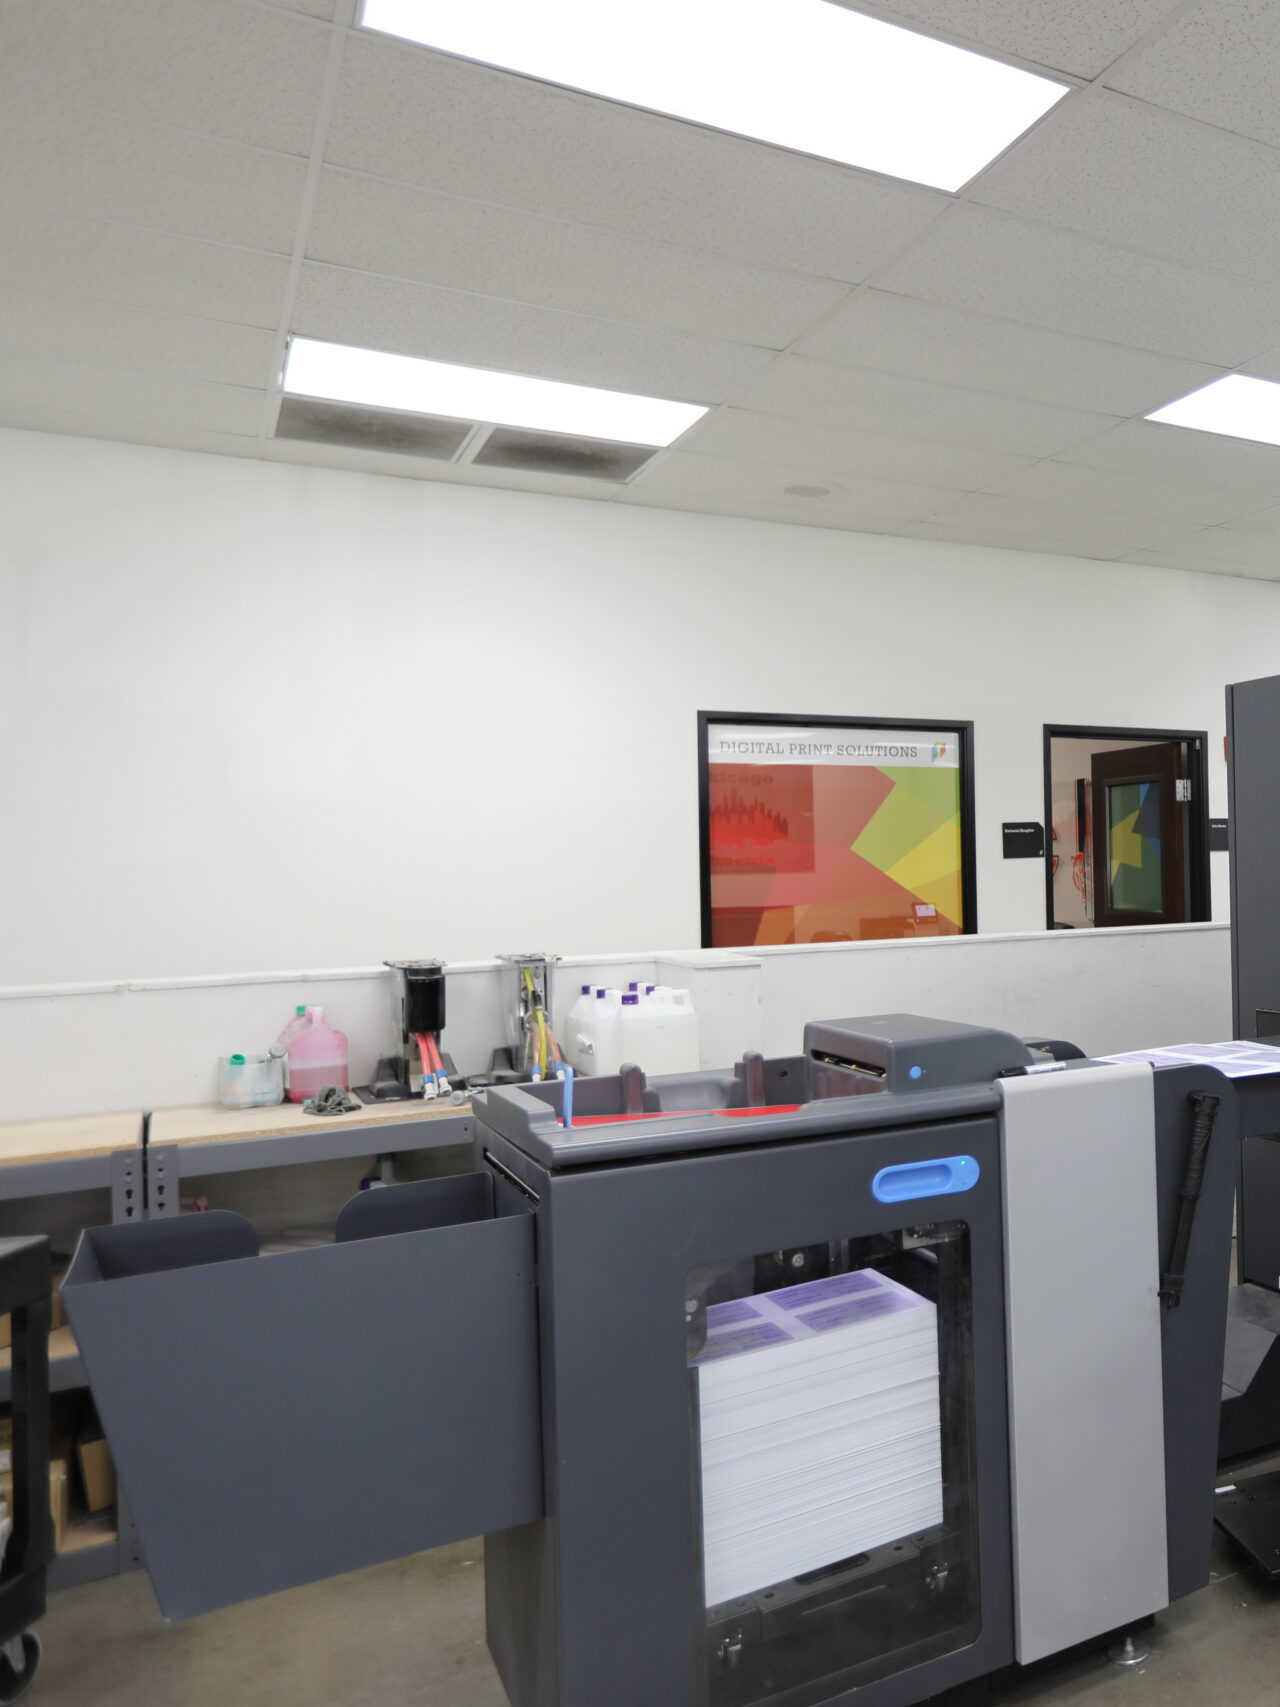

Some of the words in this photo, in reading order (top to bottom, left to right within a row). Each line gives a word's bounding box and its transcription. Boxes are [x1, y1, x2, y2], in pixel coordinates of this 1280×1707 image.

[719, 741, 785, 755] DIGITAL
[788, 743, 833, 756] PRINT
[836, 744, 918, 758] SOLUTIONS
[710, 769, 774, 788] hicago
[710, 853, 776, 866] hoenix
